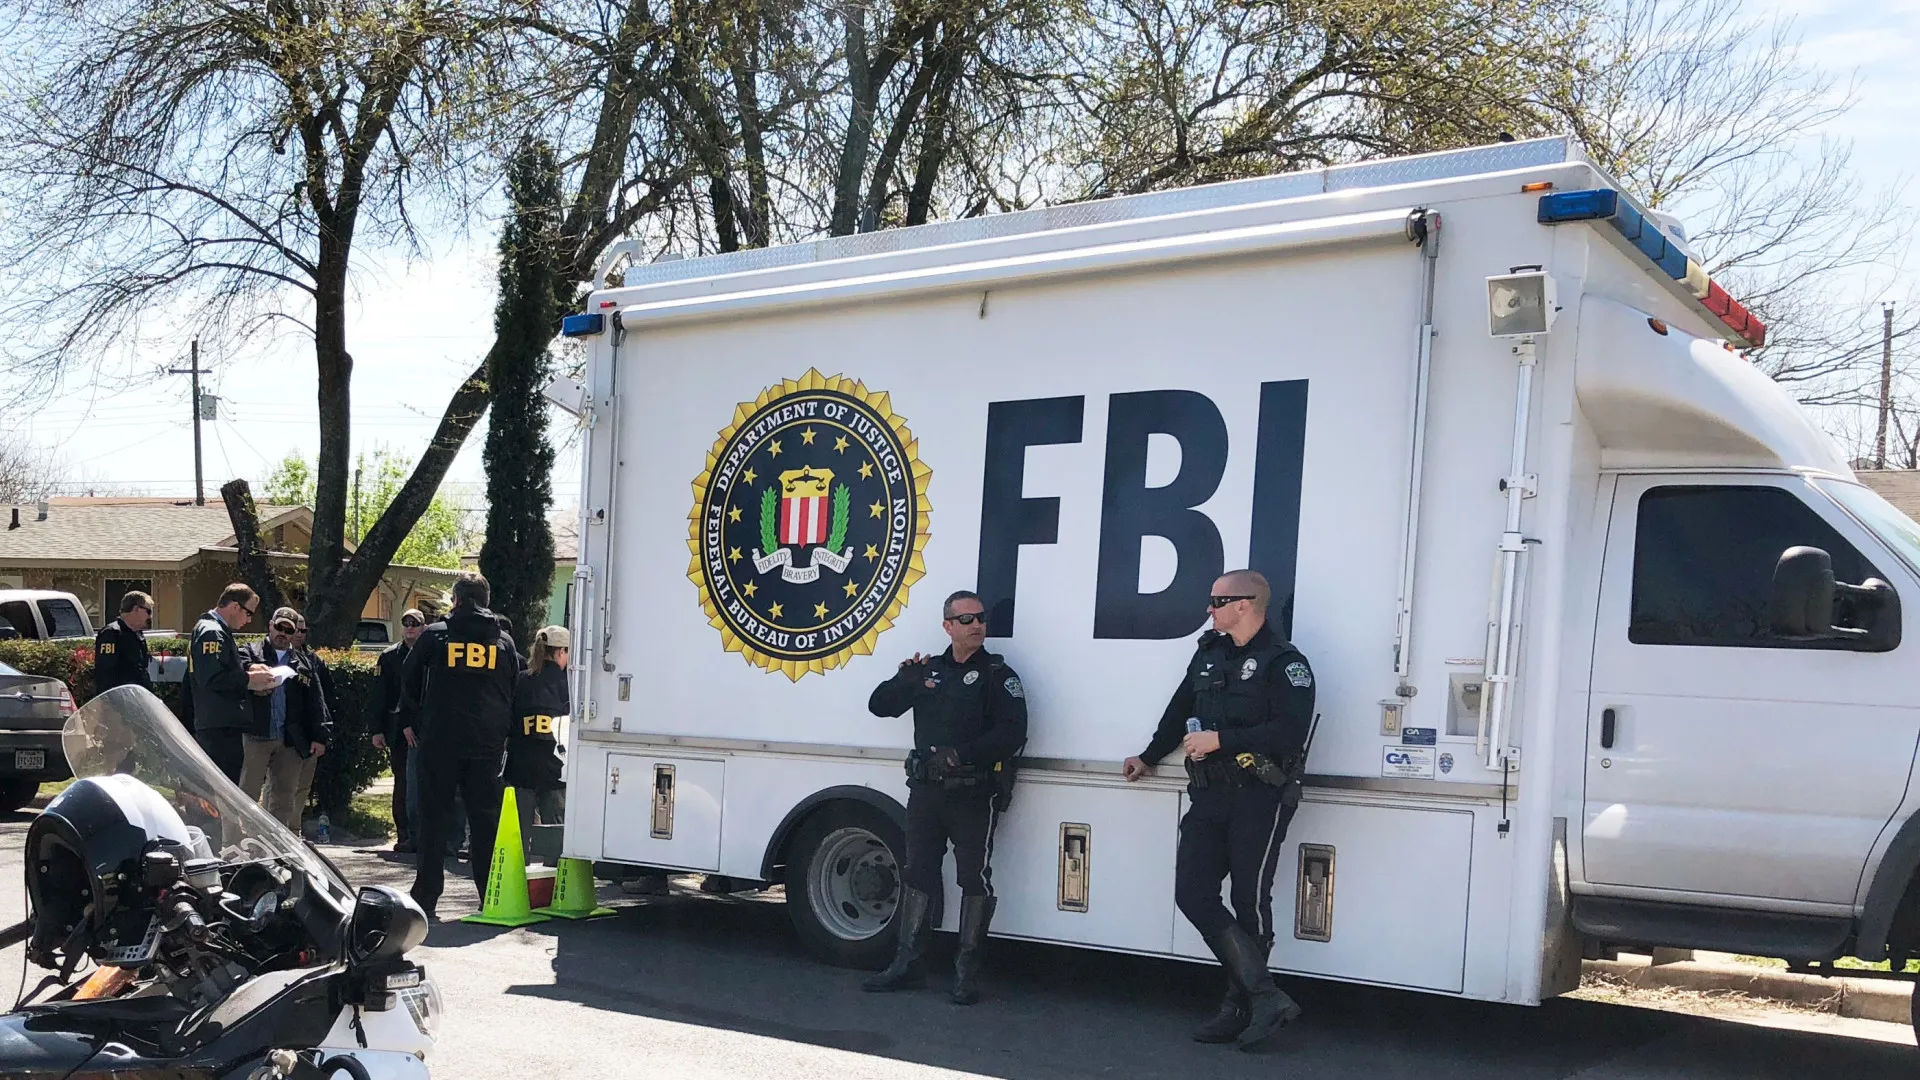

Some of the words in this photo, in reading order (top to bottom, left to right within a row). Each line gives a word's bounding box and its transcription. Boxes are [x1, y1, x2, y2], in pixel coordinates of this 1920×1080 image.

[718, 401, 818, 492] DEPARTMENT
[824, 402, 849, 421] OF
[848, 412, 902, 485] JUSTICE
[974, 378, 1309, 641] FBI
[758, 551, 788, 571] FIDELITY
[814, 550, 847, 570] INTEGRITY
[708, 504, 730, 600] FEDERAL
[728, 599, 789, 648] BUREAU
[795, 632, 818, 649] OF
[824, 498, 906, 643] INVESTIGATION
[783, 568, 818, 580] BRAVERY
[100, 643, 115, 654] FBI
[202, 641, 221, 655] FBI
[447, 642, 497, 670] FBI
[523, 714, 552, 736] FB
[493, 847, 505, 906] CUIDADO
[560, 860, 568, 901] IDADO
